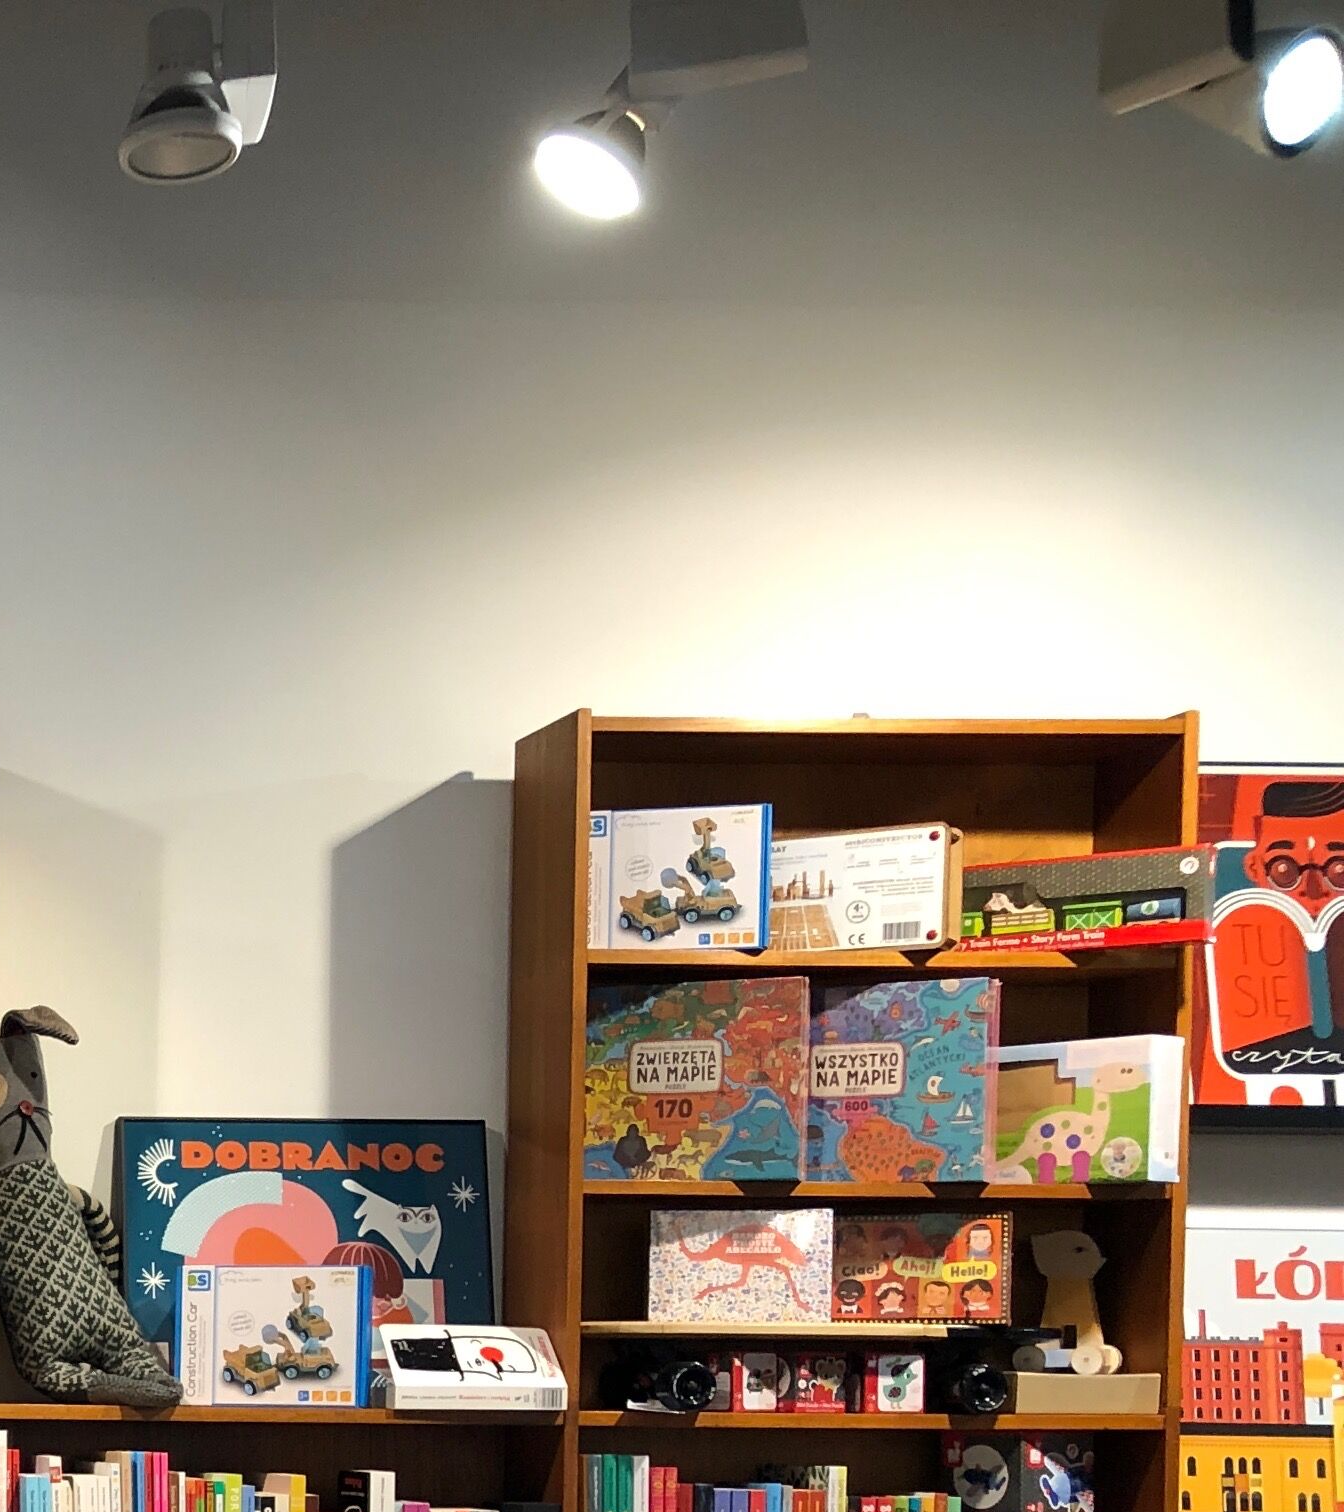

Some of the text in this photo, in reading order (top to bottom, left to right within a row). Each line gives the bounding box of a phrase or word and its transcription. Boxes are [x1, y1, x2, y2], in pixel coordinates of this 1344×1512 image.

[1031, 934, 1054, 945] Story
[1083, 930, 1105, 940] Train
[1232, 923, 1286, 966] TU
[1234, 975, 1292, 1026] SIĘ
[636, 1051, 717, 1068] ZWIERZĘTA
[814, 1052, 899, 1070] WSZYSTKO
[636, 1065, 717, 1083] NA MAPIE
[817, 1069, 898, 1088] NA MAPIE
[654, 1099, 693, 1119] 170
[844, 1100, 869, 1112] 600
[181, 1140, 445, 1173] DOBRANOC
[841, 1259, 988, 1278] Ciao! Ahoj! Hello!
[185, 1302, 198, 1398] Construction Car
